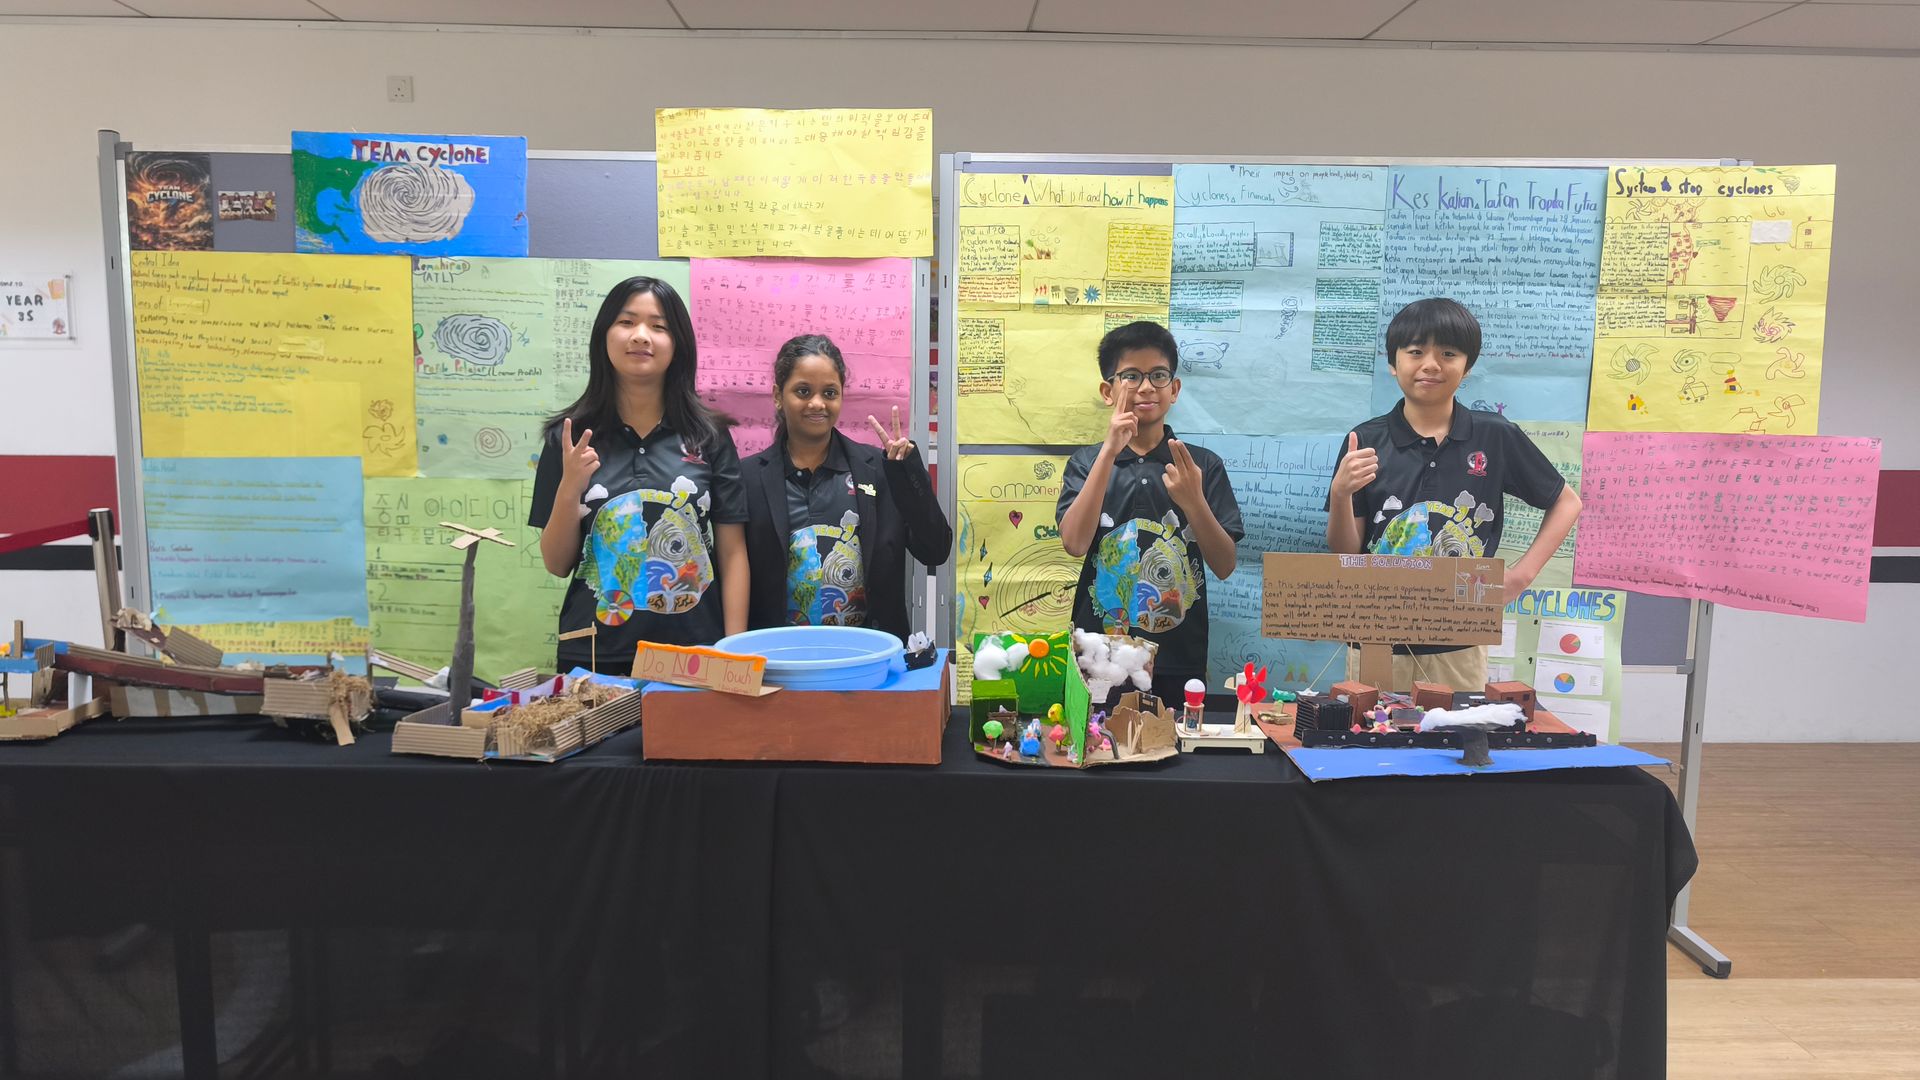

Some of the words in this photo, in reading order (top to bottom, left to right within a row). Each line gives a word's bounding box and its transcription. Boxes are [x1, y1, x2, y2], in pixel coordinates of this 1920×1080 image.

[351, 139, 411, 162] TEAM
[1273, 169, 1294, 180] impact
[1392, 173, 1430, 210] Kes
[1481, 179, 1520, 210] Taufan
[1567, 183, 1598, 214] Fytia
[1678, 176, 1703, 196] stop
[1717, 176, 1774, 198] cyclones
[146, 190, 195, 202] CYCLONE
[1029, 179, 1064, 204] What
[1070, 190, 1076, 204] is
[1078, 185, 1085, 202] it
[1086, 189, 1102, 203] and
[1103, 182, 1124, 207] how
[1126, 188, 1135, 206] it
[1138, 180, 1169, 209] happens
[1508, 222, 1528, 232] Timur
[423, 272, 454, 284] (ATL)
[5, 294, 44, 307] YEAR
[1241, 440, 1269, 480] study
[1275, 440, 1309, 480] Tropical
[1310, 441, 1336, 481] Cyclon
[1310, 485, 1321, 498] 28
[372, 493, 410, 525] 중심
[424, 494, 516, 524] 아이디어
[1284, 497, 1296, 510] The
[1426, 501, 1456, 518] YEAR
[1260, 530, 1277, 546] large
[1340, 554, 1367, 567] THE
[1371, 556, 1433, 570] SOLUTION
[377, 582, 390, 601] 2
[1363, 582, 1390, 594] cyclone
[1286, 591, 1298, 599] and
[1341, 601, 1352, 610] and
[1517, 588, 1617, 622] CYCLONES
[1283, 610, 1295, 620] will
[1322, 621, 1335, 629] that
[1374, 622, 1385, 630] the
[1286, 629, 1298, 637] who
[641, 647, 666, 674] Do
[672, 652, 715, 681] NOT
[720, 659, 753, 684] Touch
